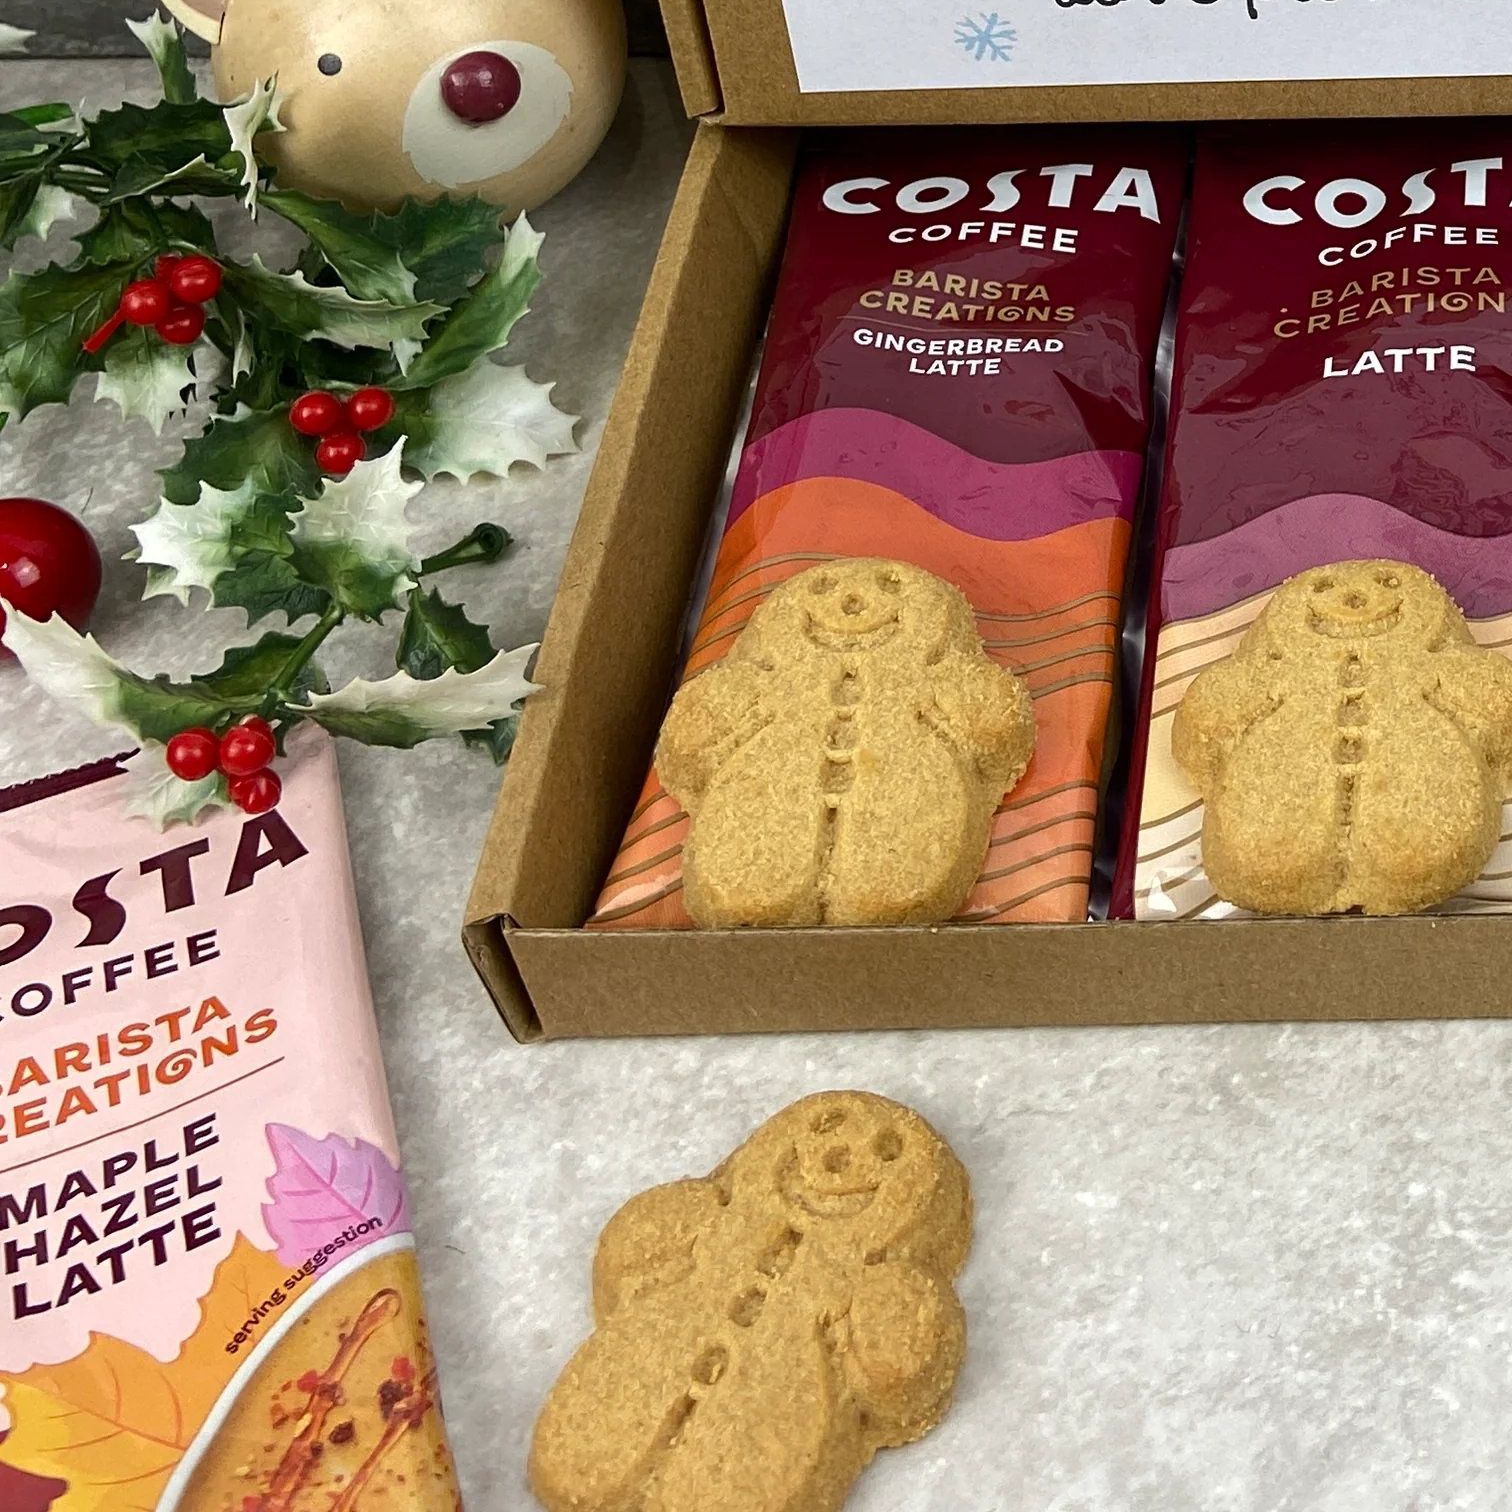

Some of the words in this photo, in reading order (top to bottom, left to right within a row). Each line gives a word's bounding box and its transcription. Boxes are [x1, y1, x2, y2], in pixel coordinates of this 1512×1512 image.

[822, 164, 1161, 224] COSTA
[888, 222, 1079, 254] COFFEE
[1318, 223, 1499, 266] COFFEE
[858, 290, 1076, 322] CREATIONS
[892, 269, 1050, 301] BARISTA
[1310, 267, 1501, 308] BARISTA
[852, 328, 1065, 356] GINGERBREAD
[908, 357, 1001, 376] LATTE
[1322, 345, 1476, 378] LATTE
[0, 808, 309, 966] OSTA
[0, 929, 220, 1021] OFFEE
[0, 996, 231, 1096] ARISTA
[0, 1008, 277, 1144] EATIONS
[0, 1112, 220, 1231] MAPLE
[4, 1164, 222, 1275] HAZEL
[12, 1202, 222, 1320] LATTE
[225, 1288, 286, 1355] serving
[284, 1216, 383, 1291] suggestion
